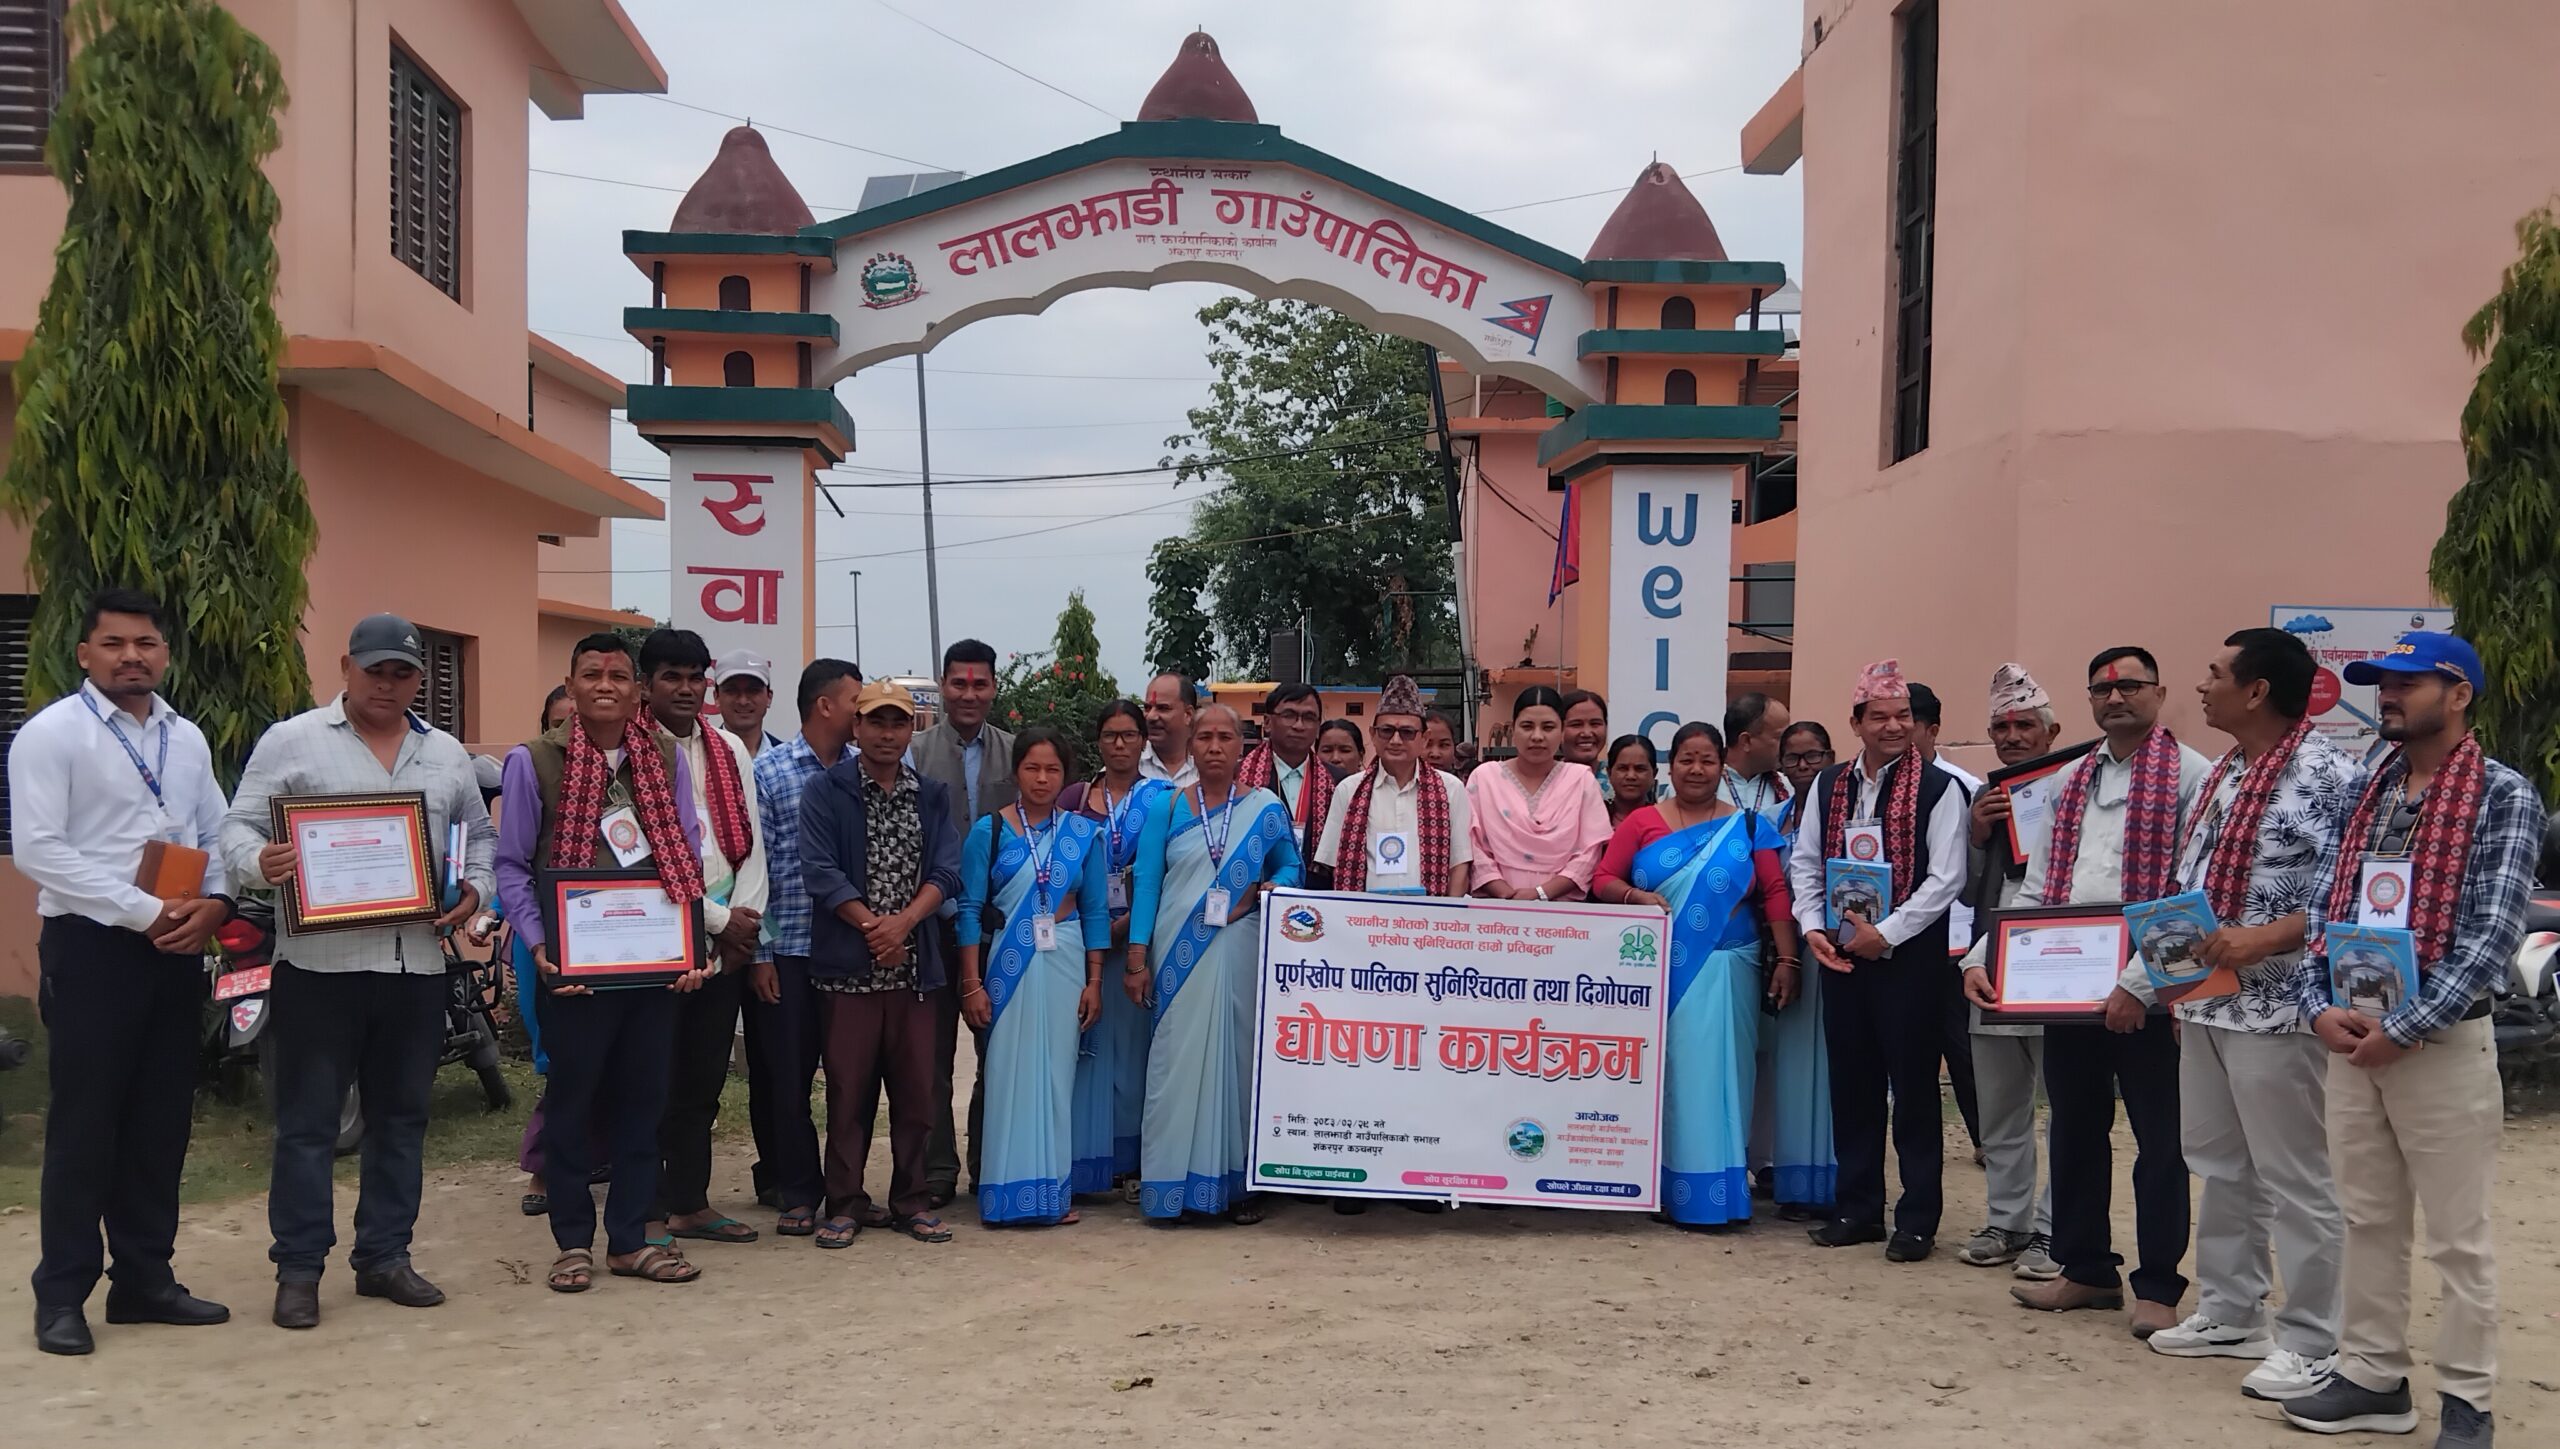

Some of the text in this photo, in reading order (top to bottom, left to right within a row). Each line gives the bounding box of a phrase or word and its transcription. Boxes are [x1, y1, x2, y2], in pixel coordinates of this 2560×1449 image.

[1149, 165, 1251, 180] स्थानीय सरकार
[937, 177, 1488, 311] लालझाडी गाउँपालिका
[1346, 915, 1388, 928] स्थानीय
[1476, 921, 1520, 936] स्वामित्व
[1523, 927, 1532, 937] र
[1368, 934, 1409, 947] पूर्णखोप
[1413, 935, 1474, 950] सुनिश्चितता
[1478, 940, 1503, 952] हाम्रो
[1275, 959, 1652, 1008] पूर्णखोप पालिका सुनिश्चितता तथा दिगोपना
[1275, 1002, 1646, 1083] घोषणा कार्यक्रम
[1574, 1110, 1620, 1122] आयोजक
[1314, 1130, 1352, 1140] लालझाडी
[1356, 1131, 1409, 1143] गाउँपालिकाको
[1347, 1144, 1384, 1156] कञ्चनपुर
[1274, 1166, 1290, 1175] खोप
[1424, 1174, 1440, 1183] खोप
